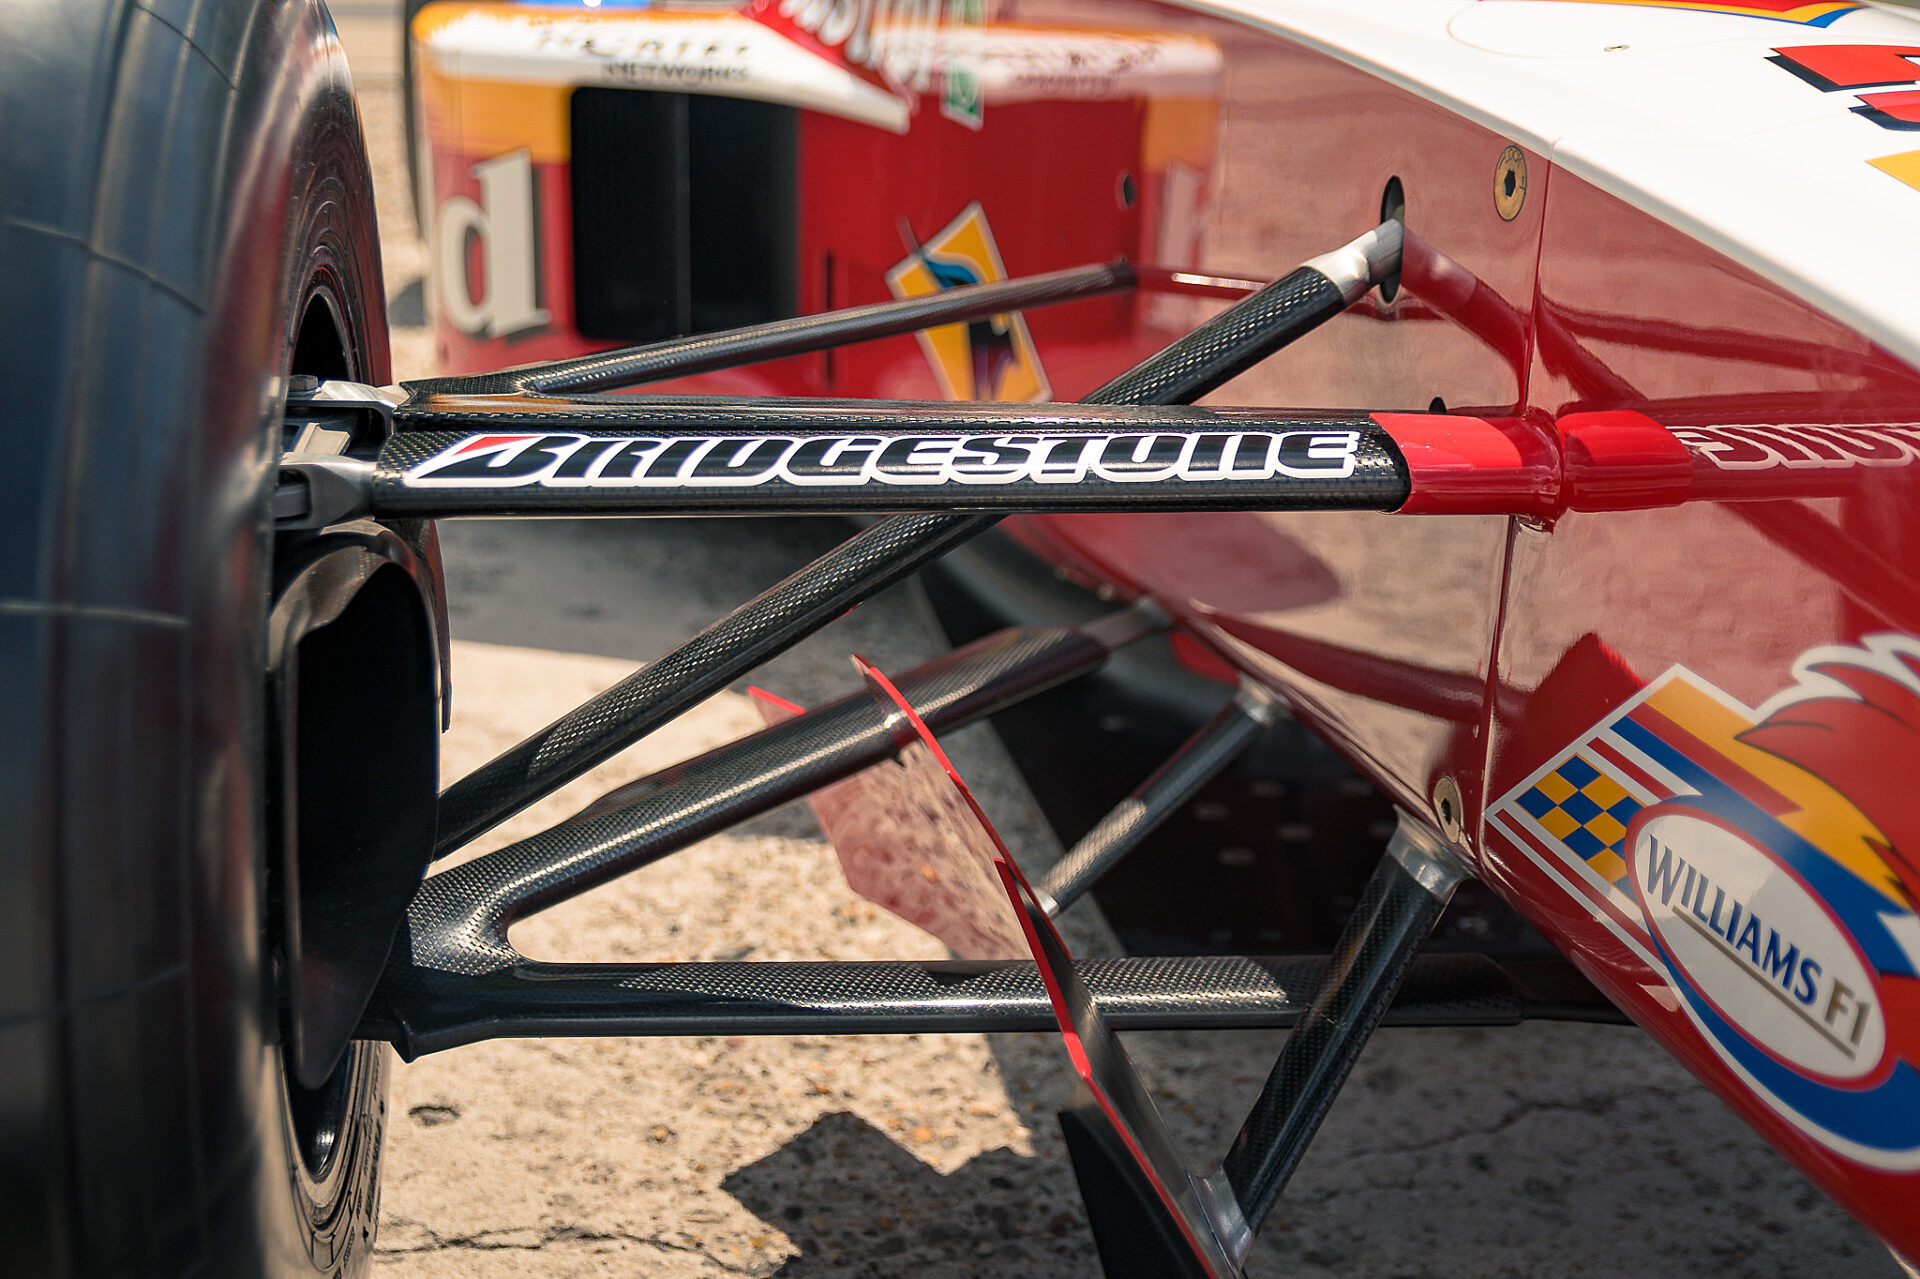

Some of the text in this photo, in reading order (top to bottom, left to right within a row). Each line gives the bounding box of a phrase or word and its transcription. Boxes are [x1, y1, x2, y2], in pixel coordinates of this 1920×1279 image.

[404, 431, 1358, 488] BRIDGESTONE
[1647, 833, 1871, 1048] WILLIAMS F1
